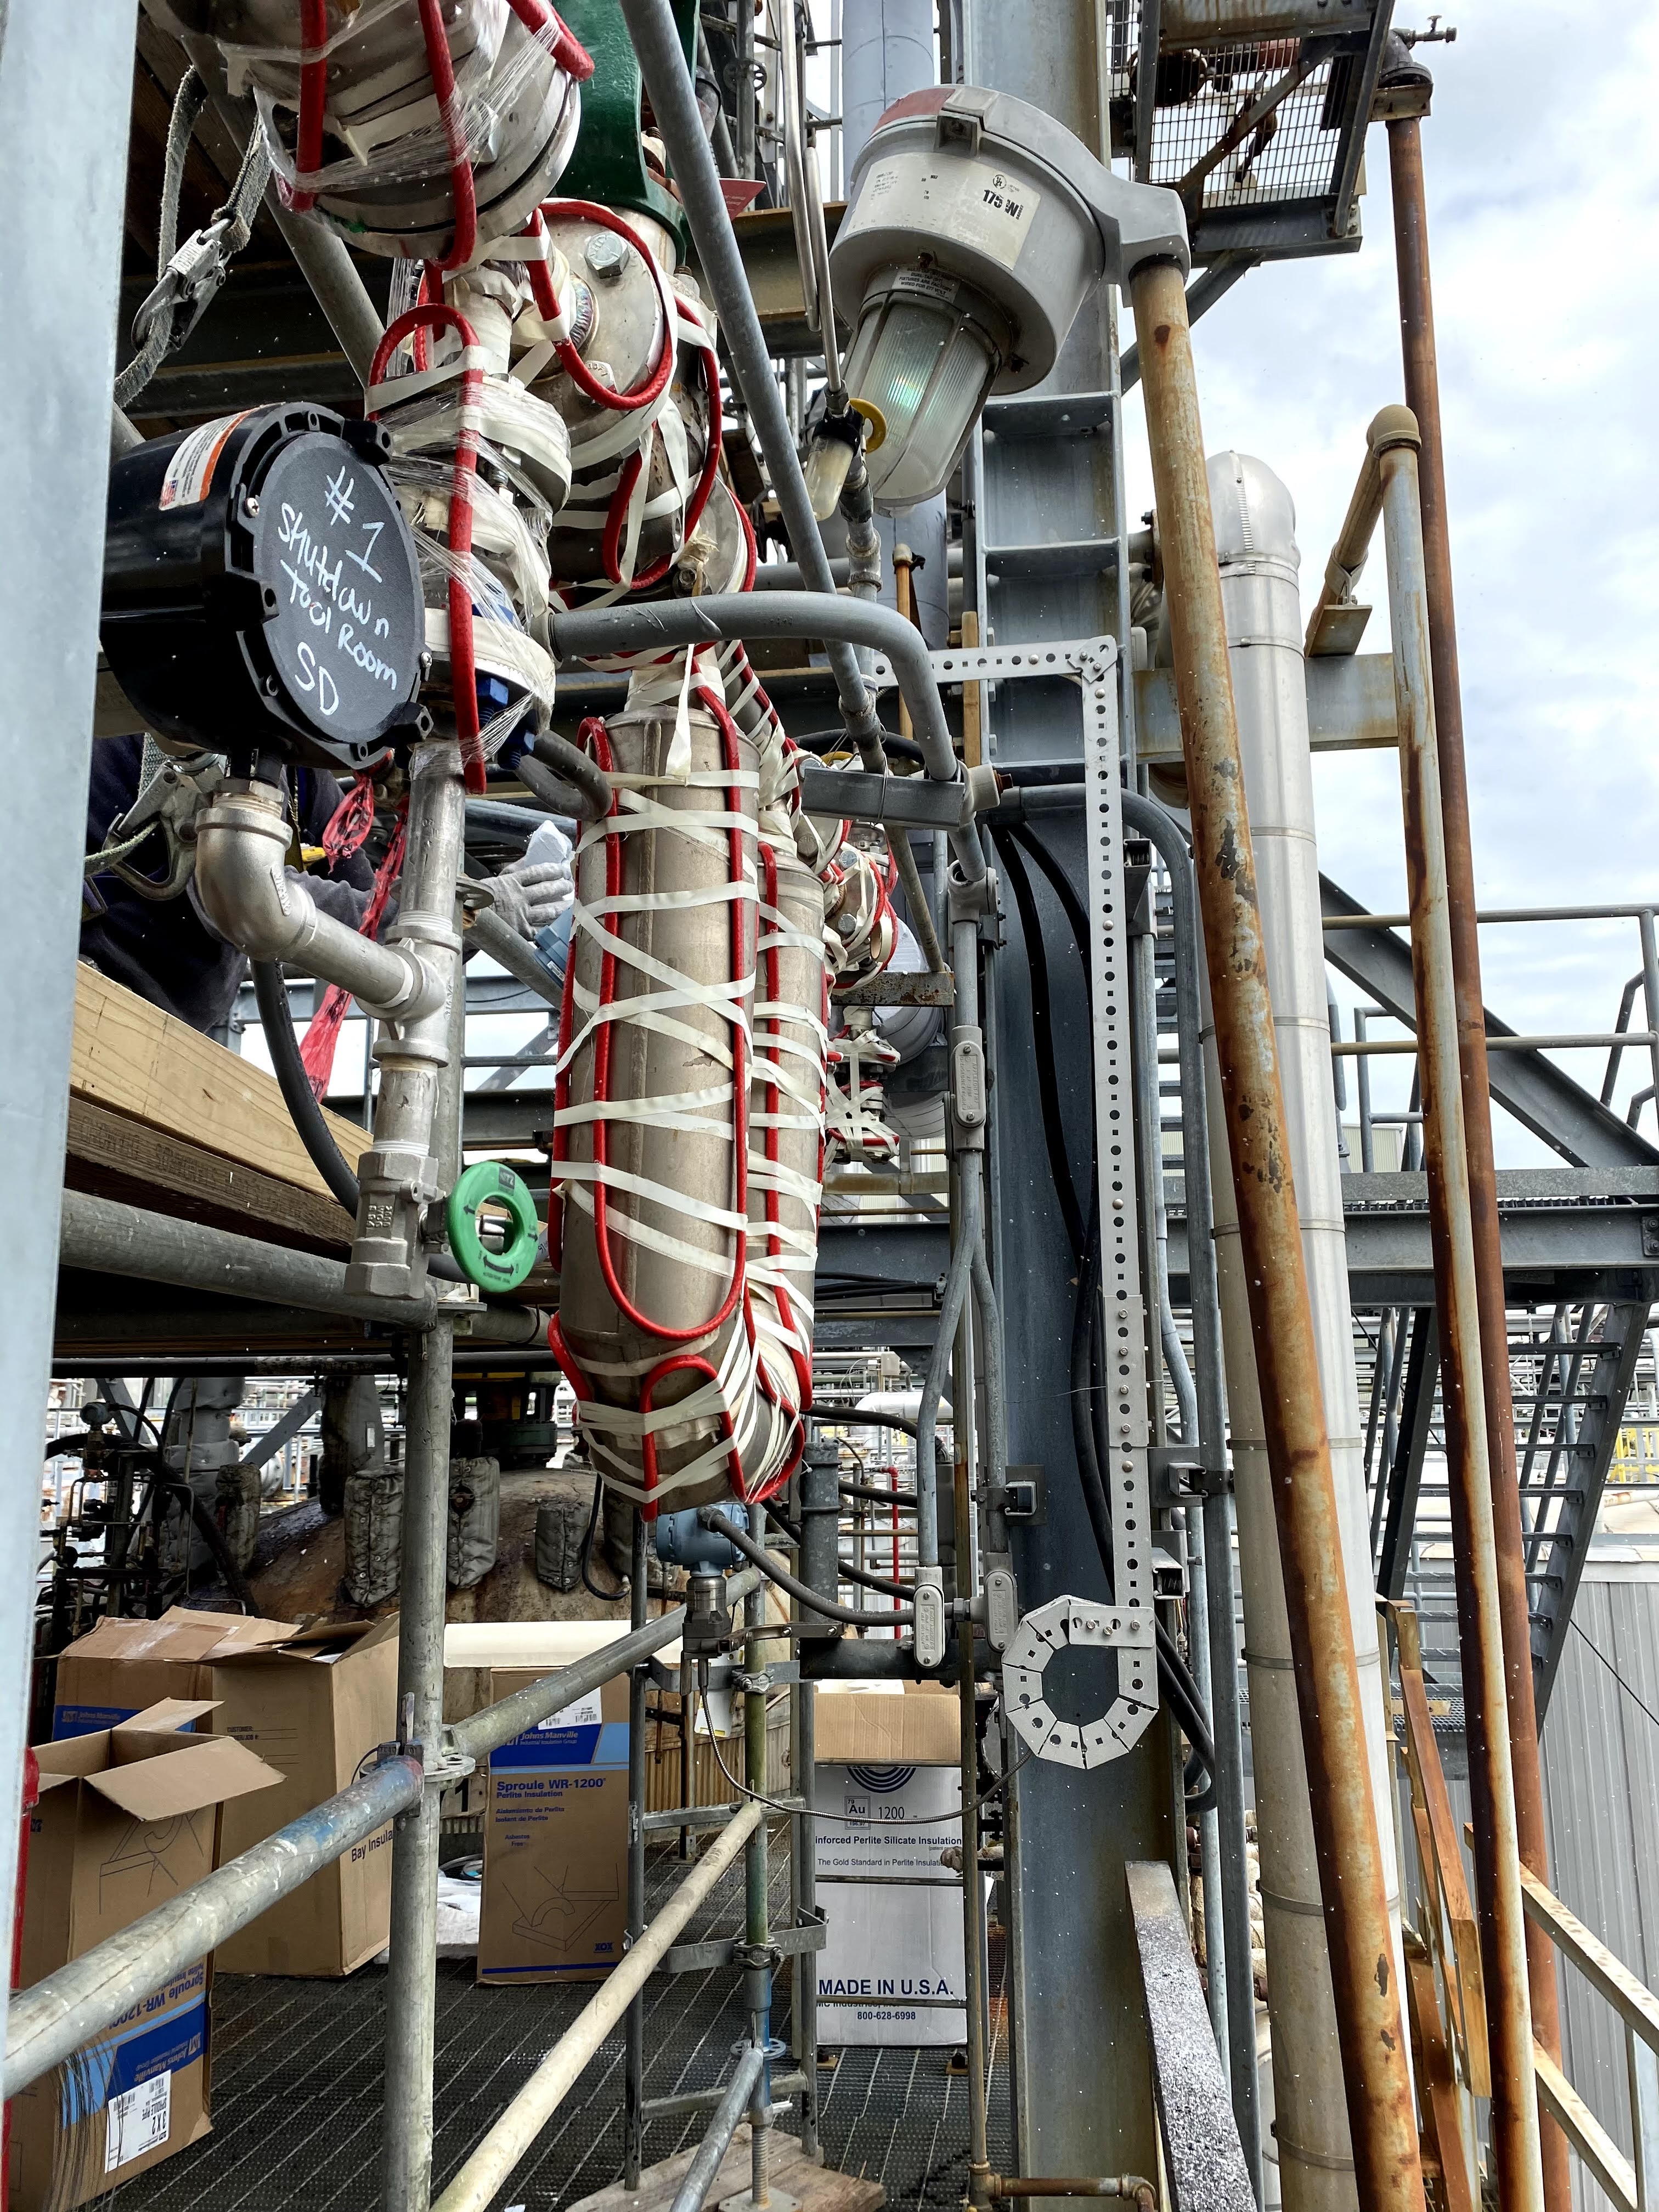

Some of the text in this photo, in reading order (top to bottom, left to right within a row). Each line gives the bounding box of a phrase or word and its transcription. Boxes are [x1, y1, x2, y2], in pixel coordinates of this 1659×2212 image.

[983, 189, 1003, 208] 175
[295, 641, 338, 715] SD
[520, 1731, 578, 1740] Johns Manville
[496, 1780, 544, 1793] Sproule
[849, 1804, 865, 1814] Au
[878, 1807, 905, 1820] 1200
[854, 1836, 881, 1844] Perlite
[884, 1836, 916, 1845] Silicate
[918, 1836, 962, 1845] Insulation
[351, 1844, 366, 1863] Bay
[168, 1971, 203, 1999] Sproule
[819, 1979, 954, 1995] MADE IN U.S.A.
[857, 2011, 916, 2020] 800-628-6998
[134, 2047, 188, 2083] Johns Manville
[151, 2111, 167, 2135] 3 X 2
